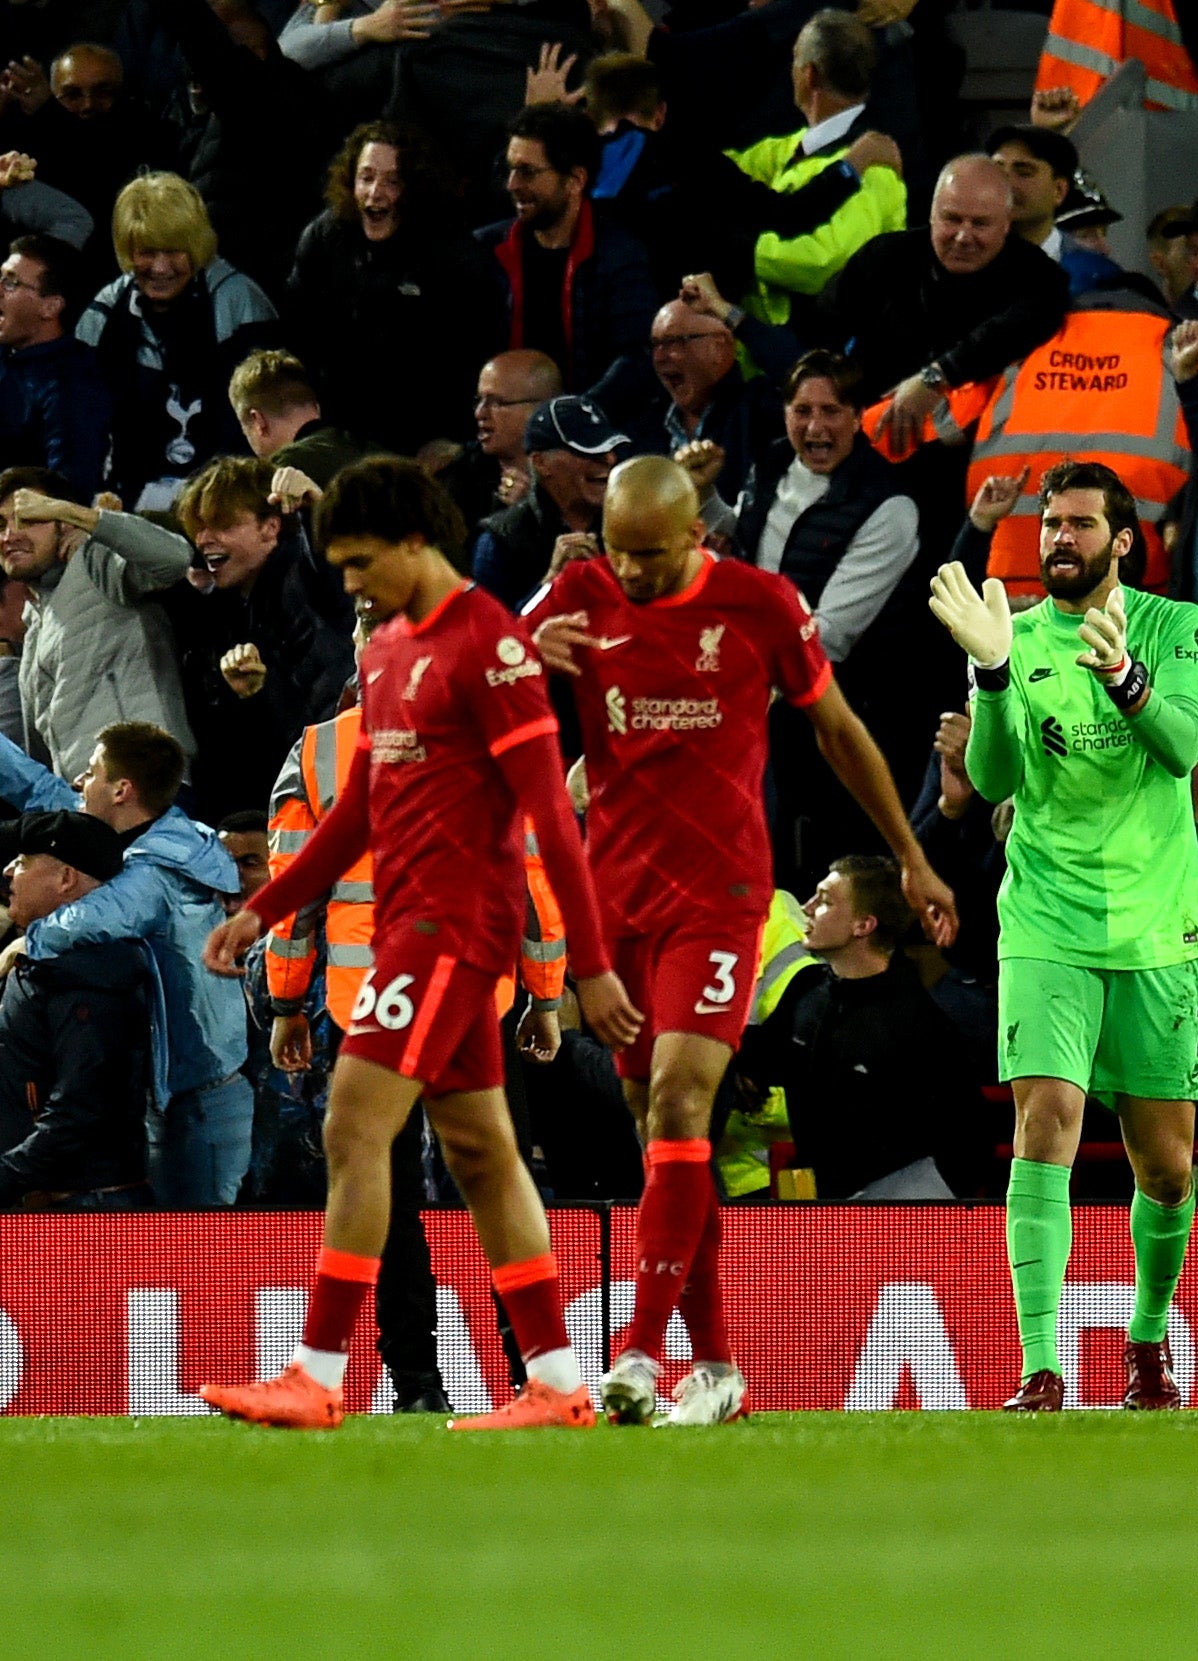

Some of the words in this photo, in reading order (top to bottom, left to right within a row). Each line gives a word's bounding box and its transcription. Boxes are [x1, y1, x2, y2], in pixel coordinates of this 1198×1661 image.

[1049, 350, 1120, 371] CROWD
[1034, 371, 1128, 392] STEWARD
[631, 696, 719, 715] standard
[631, 712, 723, 731] chartered
[1071, 718, 1128, 737] standa
[1072, 732, 1136, 752] charter
[702, 949, 739, 1004] 3
[350, 967, 415, 1031] 66
